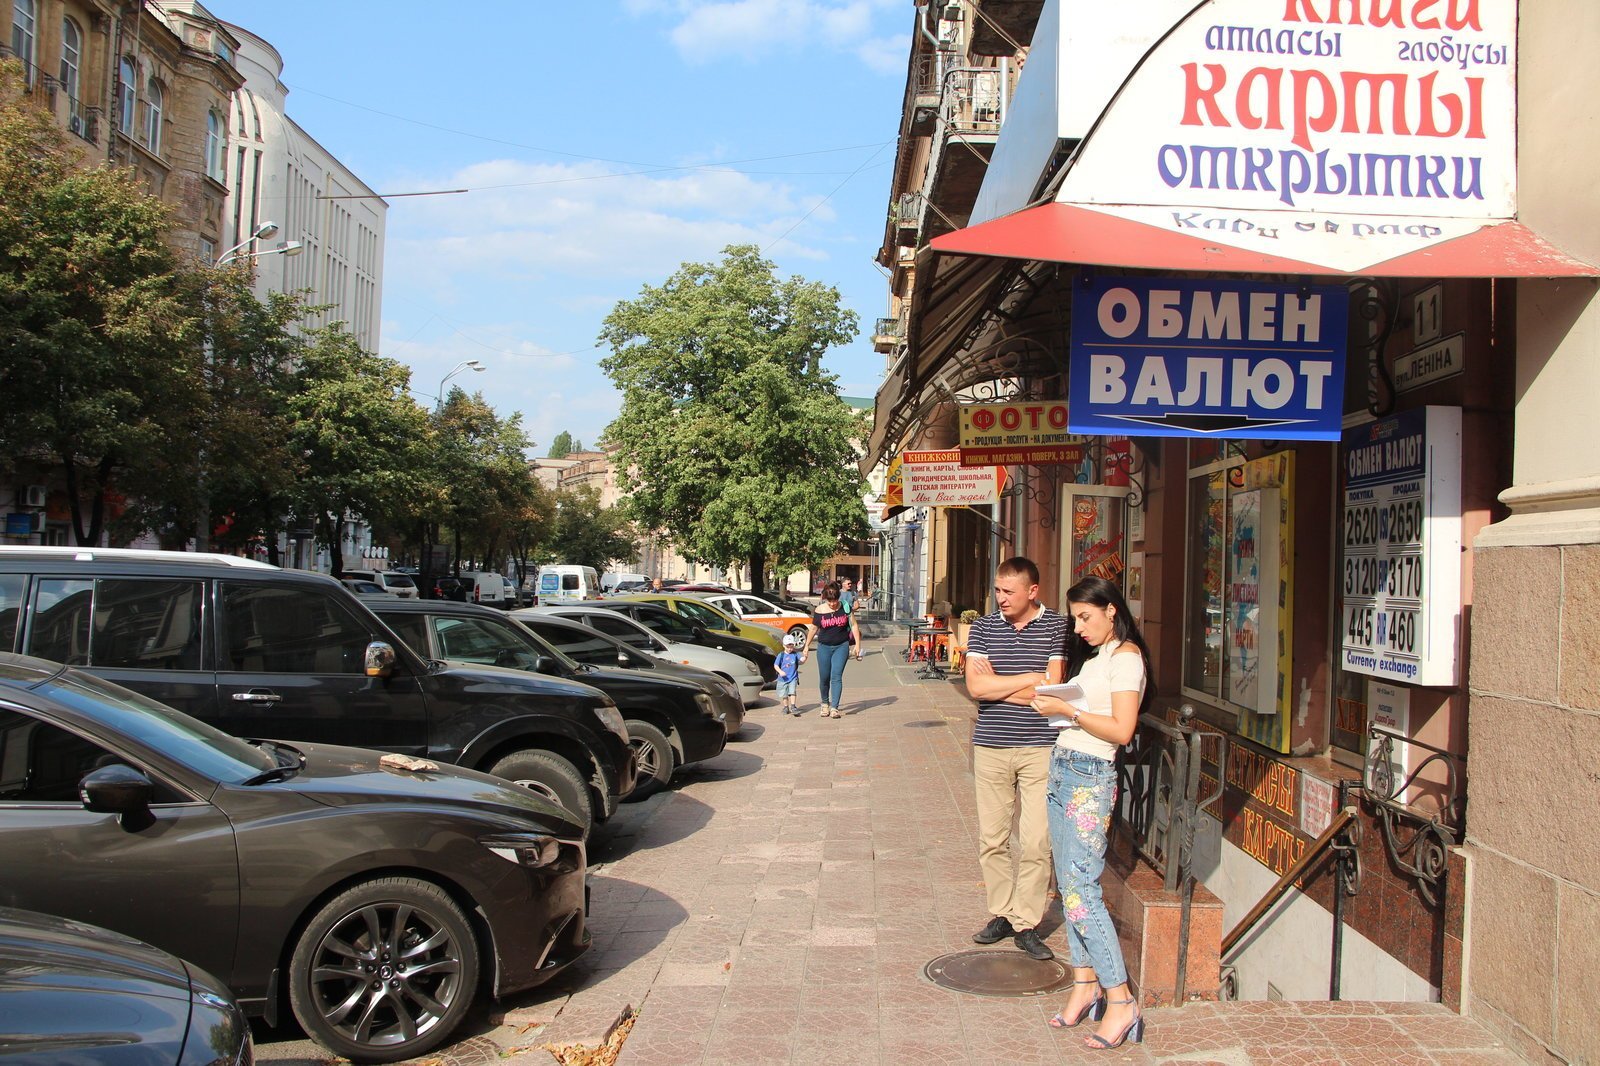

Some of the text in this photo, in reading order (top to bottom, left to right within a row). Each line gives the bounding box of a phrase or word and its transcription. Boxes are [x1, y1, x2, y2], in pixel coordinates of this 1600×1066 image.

[1205, 25, 1342, 57] атласы
[1398, 36, 1508, 69] глобусы
[1180, 62, 1486, 151] карты
[1157, 144, 1485, 206] открытки
[1097, 288, 1322, 343] ОБМЕН
[1416, 294, 1437, 336] 11
[1089, 354, 1333, 410] ВАЛЮТ
[1410, 347, 1452, 380] ЛЕНІНА
[971, 405, 1068, 431] ФОТО
[908, 452, 960, 462] КНИЖКОВИ
[1349, 434, 1422, 478] ОБМЕН ВАЛЮТ
[936, 492, 955, 501] Вас
[1348, 482, 1420, 501] ПОКУПКА ПРОДАЖА
[1346, 506, 1378, 546] 2620
[1389, 500, 1422, 544] 2650
[1346, 557, 1377, 596] 3120
[1388, 555, 1422, 598] 3170
[1349, 608, 1372, 646] 445
[1389, 611, 1415, 652] 460
[1347, 650, 1417, 678] Currency exchange
[1226, 741, 1296, 817] АТЛАСЫ
